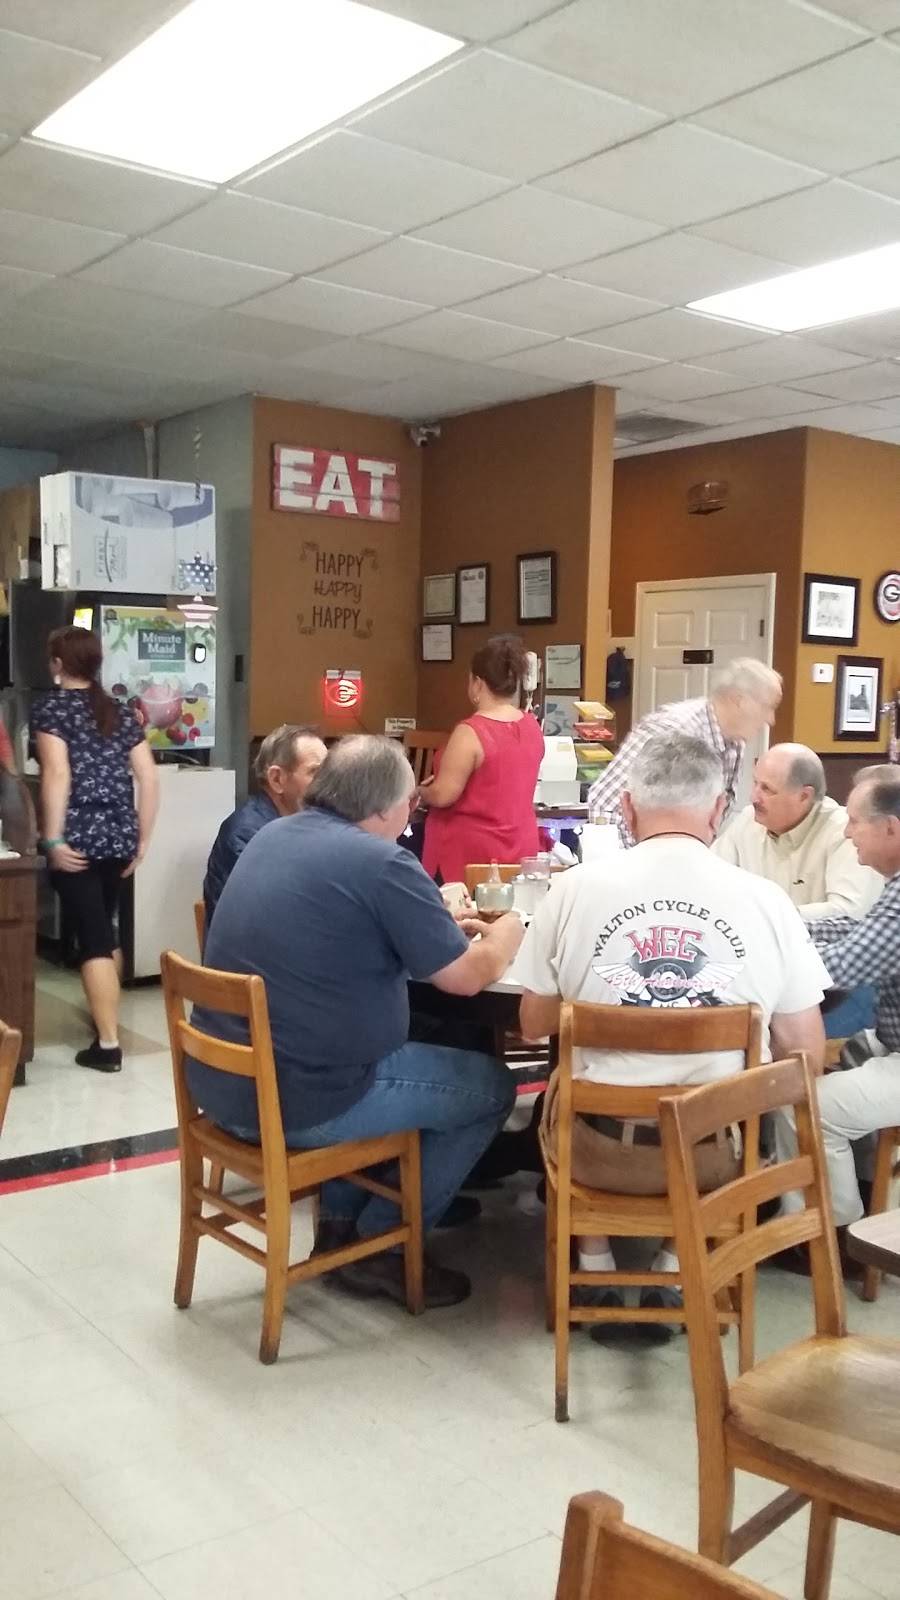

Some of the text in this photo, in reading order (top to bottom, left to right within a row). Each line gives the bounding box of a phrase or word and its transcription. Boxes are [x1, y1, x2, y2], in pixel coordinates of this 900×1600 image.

[280, 448, 396, 518] EAT
[315, 551, 364, 578] HAPPY
[312, 605, 361, 629] HAPPY
[142, 632, 182, 644] Minute
[147, 643, 177, 654] Maid
[594, 900, 746, 959] WALTON CYCLE CLUB
